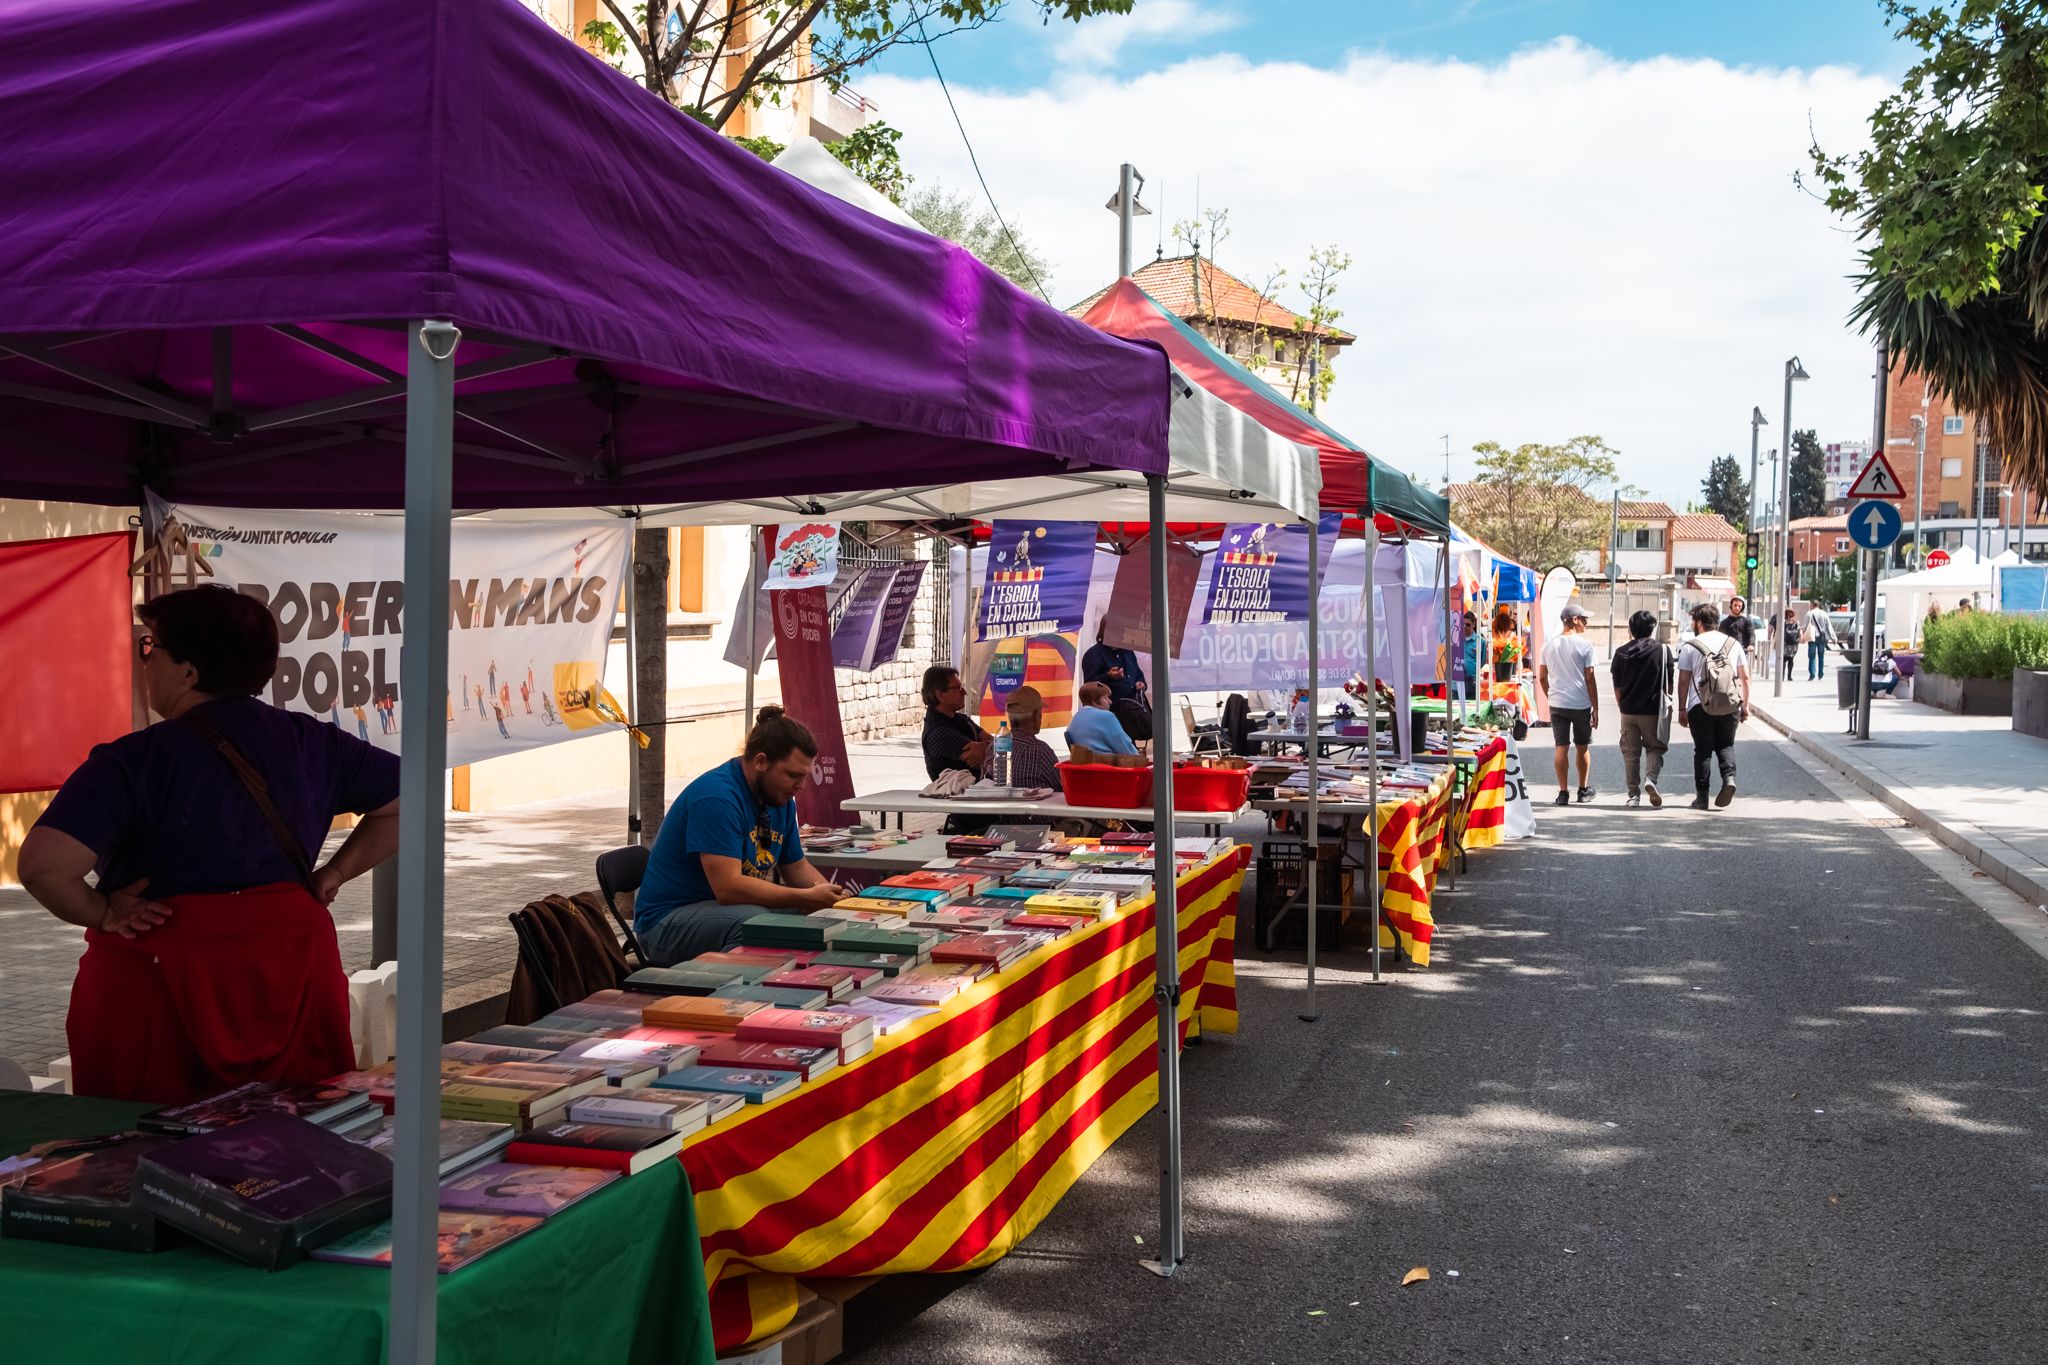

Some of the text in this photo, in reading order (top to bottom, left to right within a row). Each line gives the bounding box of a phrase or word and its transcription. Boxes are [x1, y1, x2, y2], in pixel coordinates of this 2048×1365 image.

[241, 531, 284, 544] UNITAT
[283, 531, 338, 544] POPULAR
[1927, 558, 1950, 566] STOP
[1218, 567, 1271, 588] L'ESCOLA
[990, 584, 1040, 604] L'ESCOLA
[1213, 588, 1272, 609] EN CATALÀ
[238, 580, 404, 644] ODER
[483, 575, 607, 628] MANS
[987, 600, 1041, 623] EN CATALÀ
[272, 647, 399, 713] POBL
